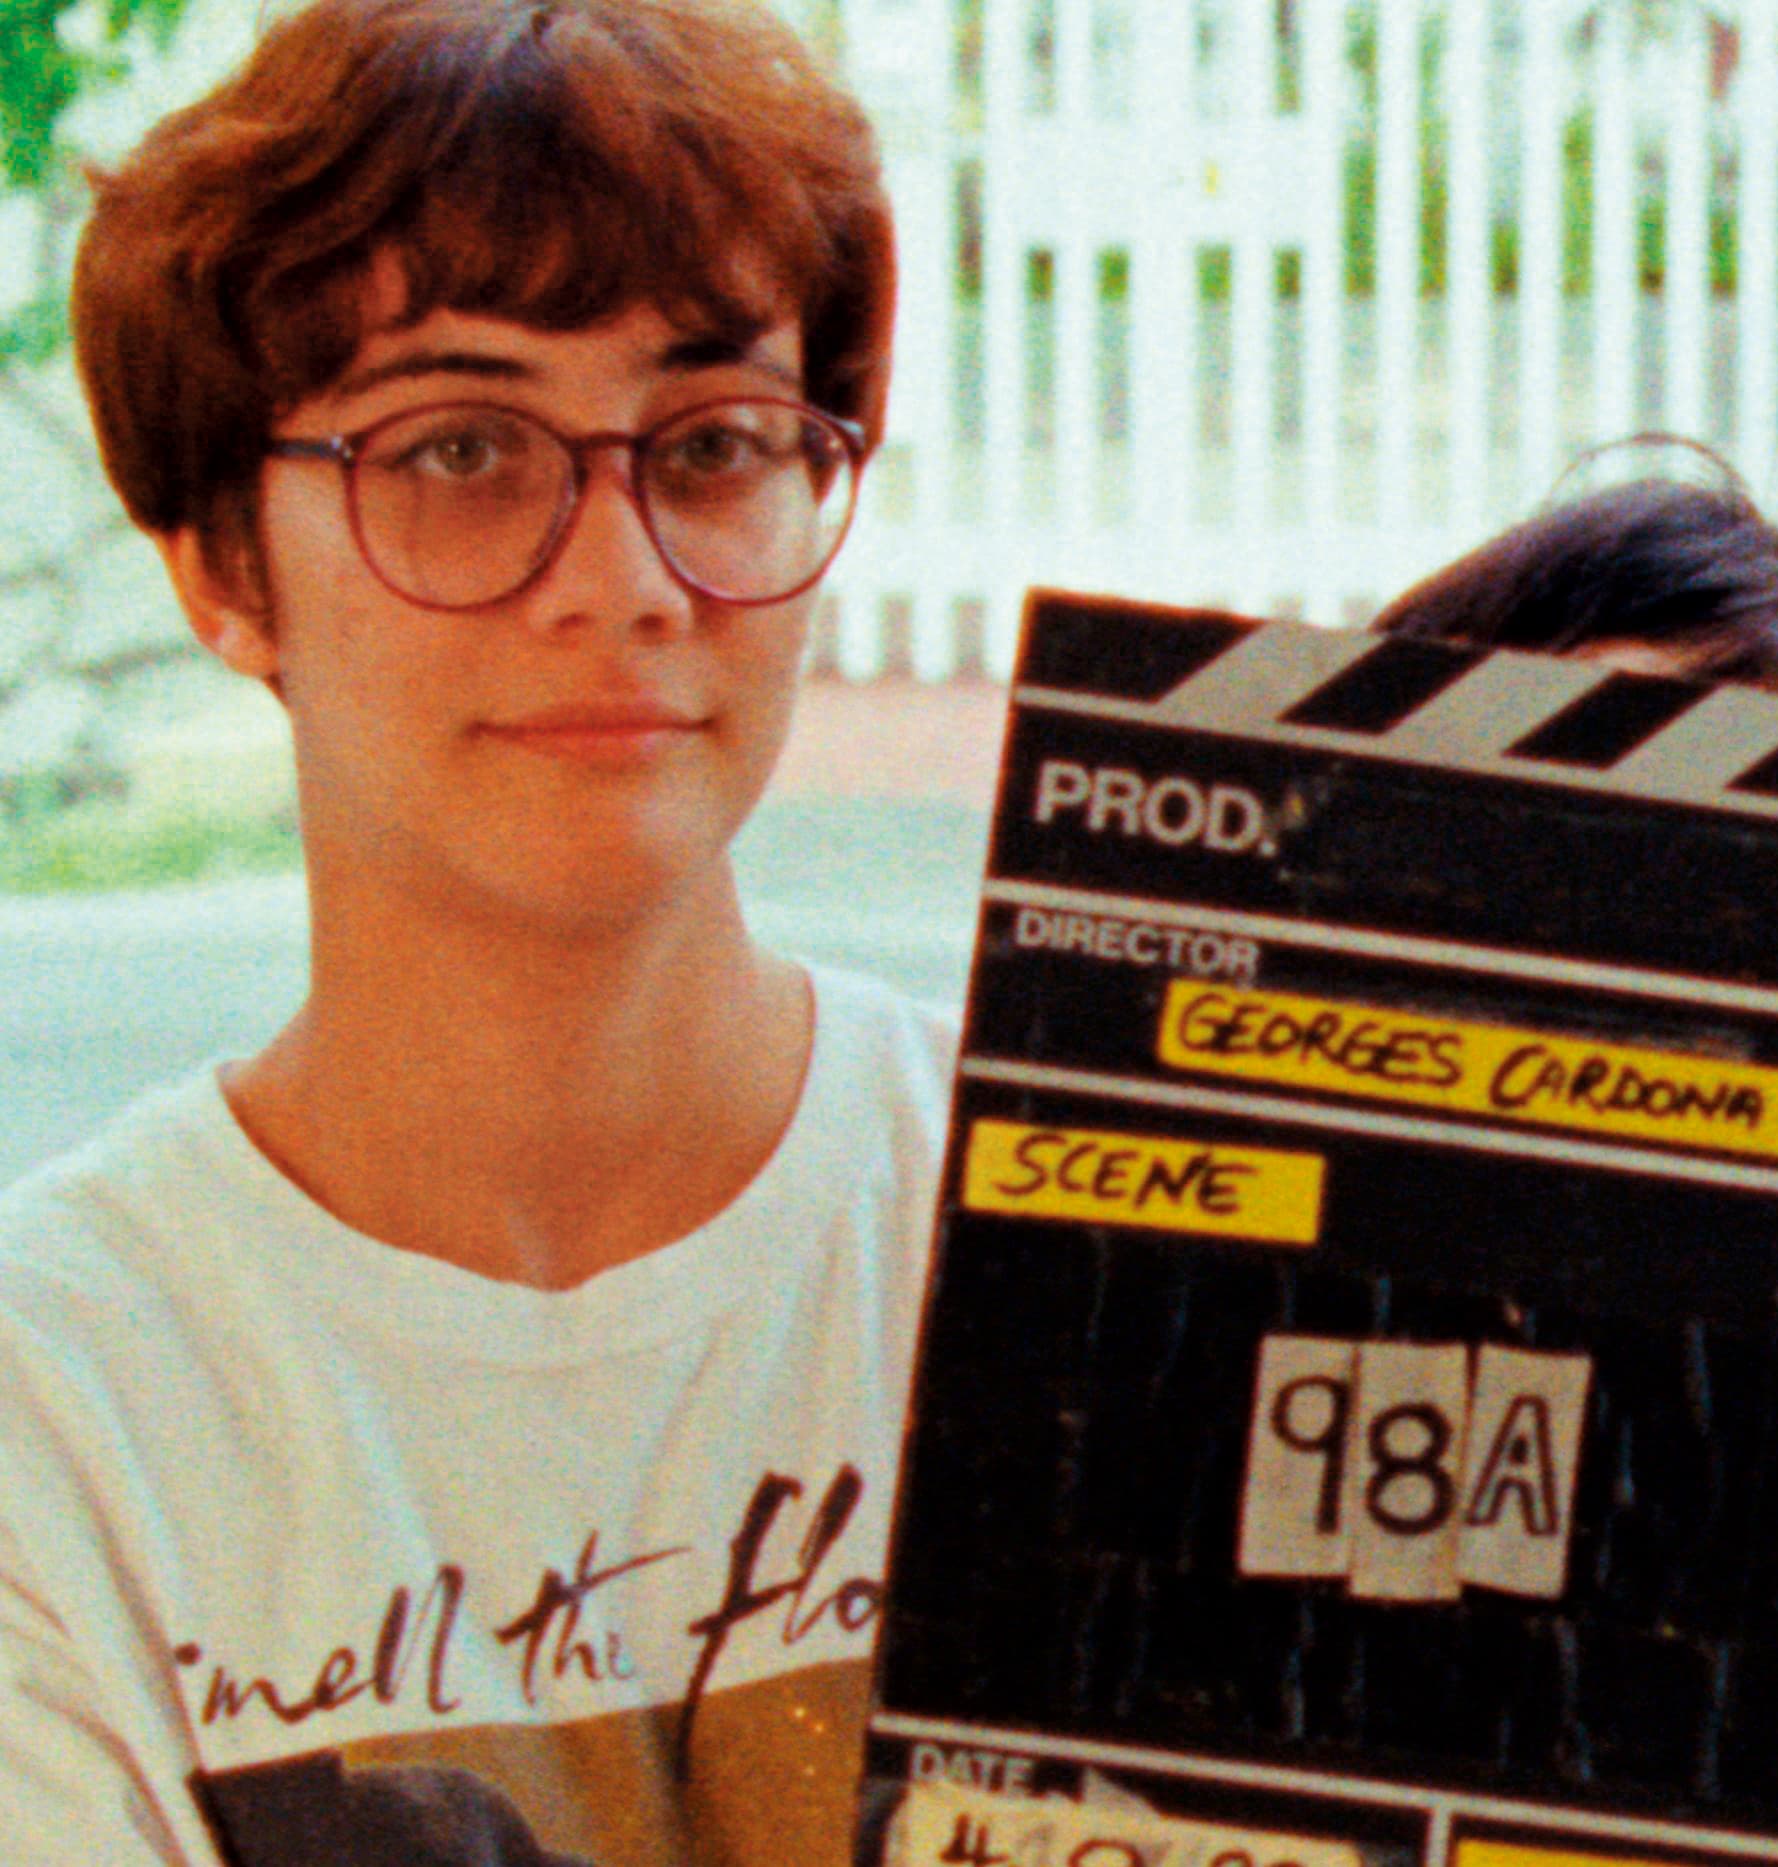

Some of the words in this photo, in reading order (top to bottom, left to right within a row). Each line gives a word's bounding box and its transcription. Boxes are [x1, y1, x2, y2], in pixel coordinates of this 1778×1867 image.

[1034, 760, 1278, 855] PROD.
[1015, 911, 1260, 976] DIRECTOR
[1178, 992, 1463, 1089] GEORGES
[1489, 1044, 1766, 1130] CARDONA
[994, 1133, 1260, 1214] SCENE
[1271, 1375, 1557, 1536] 98A
[174, 1563, 462, 1725] mell
[911, 1744, 1034, 1799] DATE
